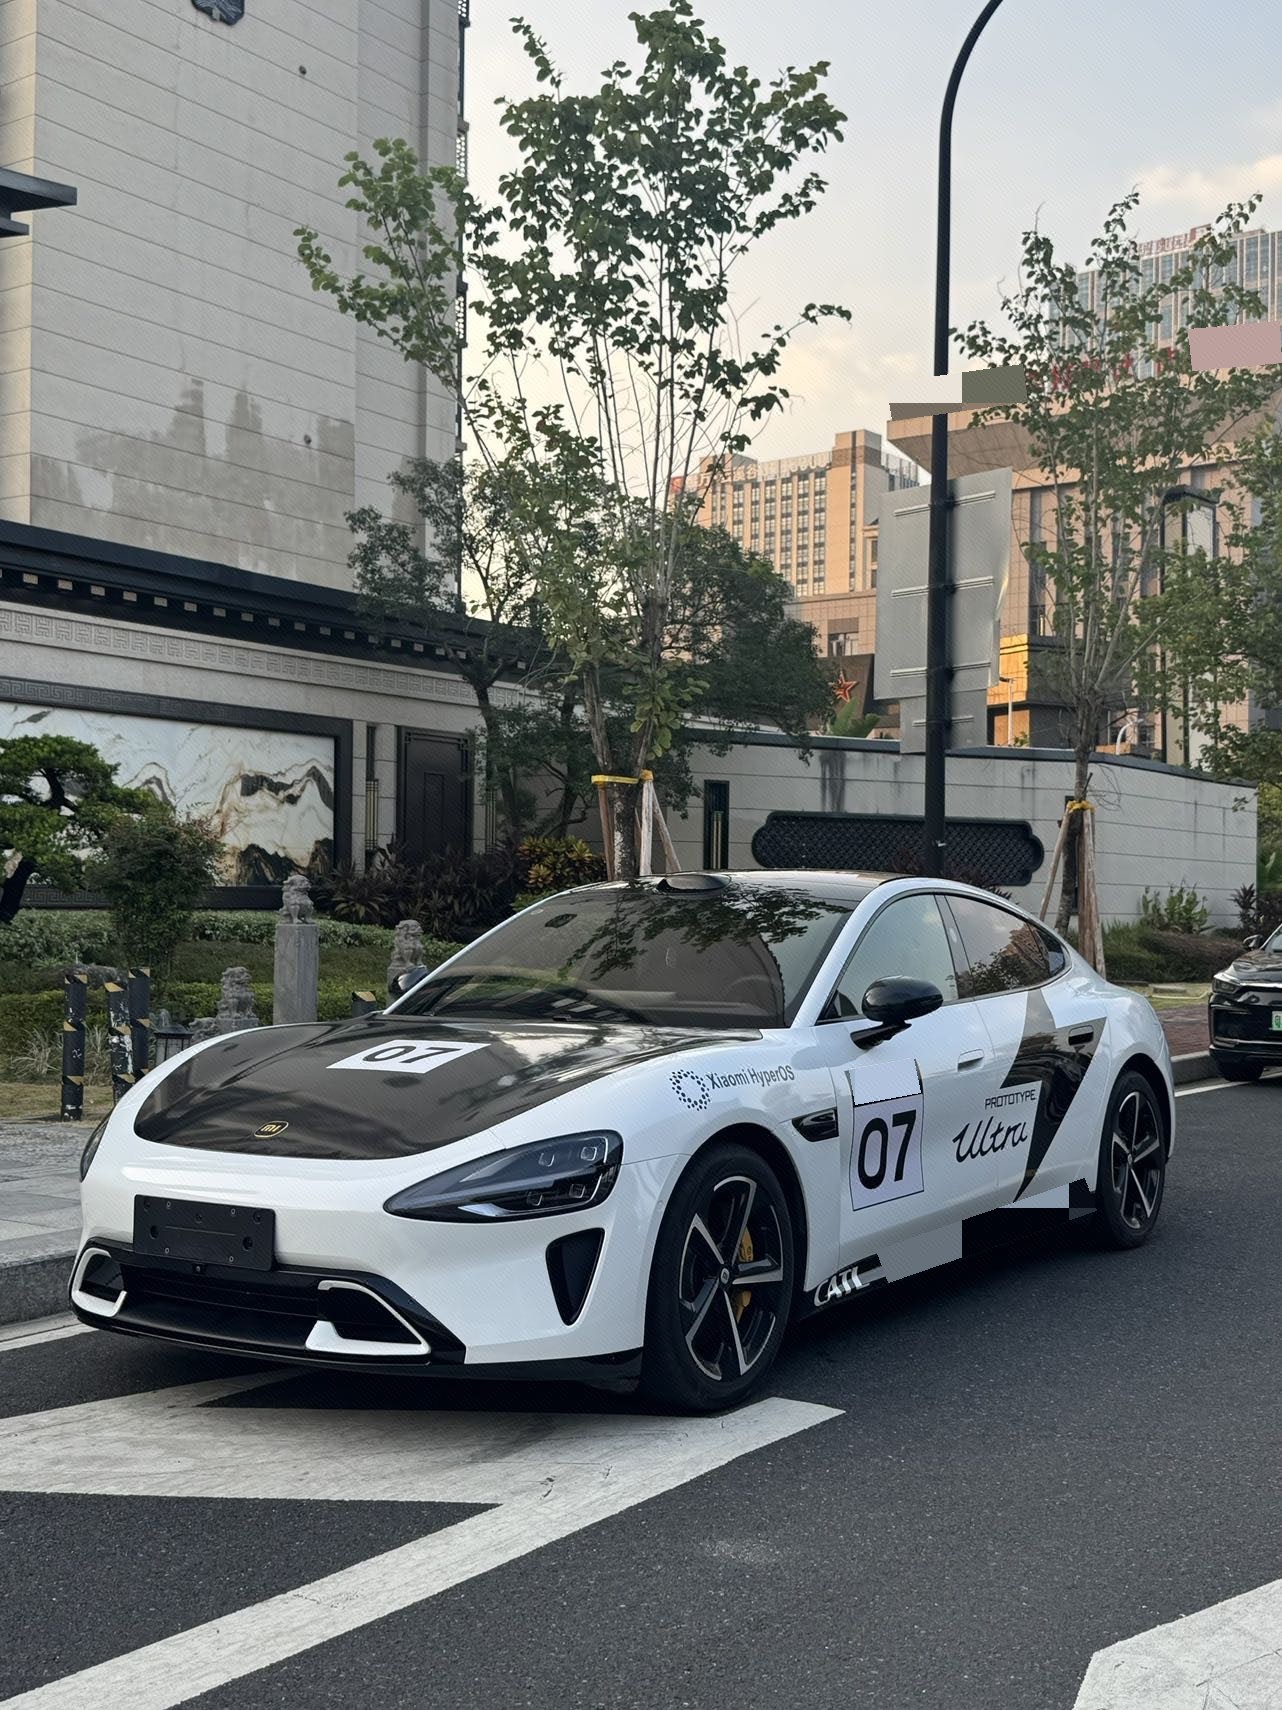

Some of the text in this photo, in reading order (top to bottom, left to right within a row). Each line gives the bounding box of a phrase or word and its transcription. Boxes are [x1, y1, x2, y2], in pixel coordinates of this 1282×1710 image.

[362, 1045, 462, 1064] 07
[706, 1065, 795, 1090] Xiaomi HyperOS
[985, 1089, 1036, 1110] PROTOTYPE
[857, 1109, 917, 1190] 07
[952, 1116, 1028, 1163] Ultra
[813, 1266, 871, 1307] CATL
